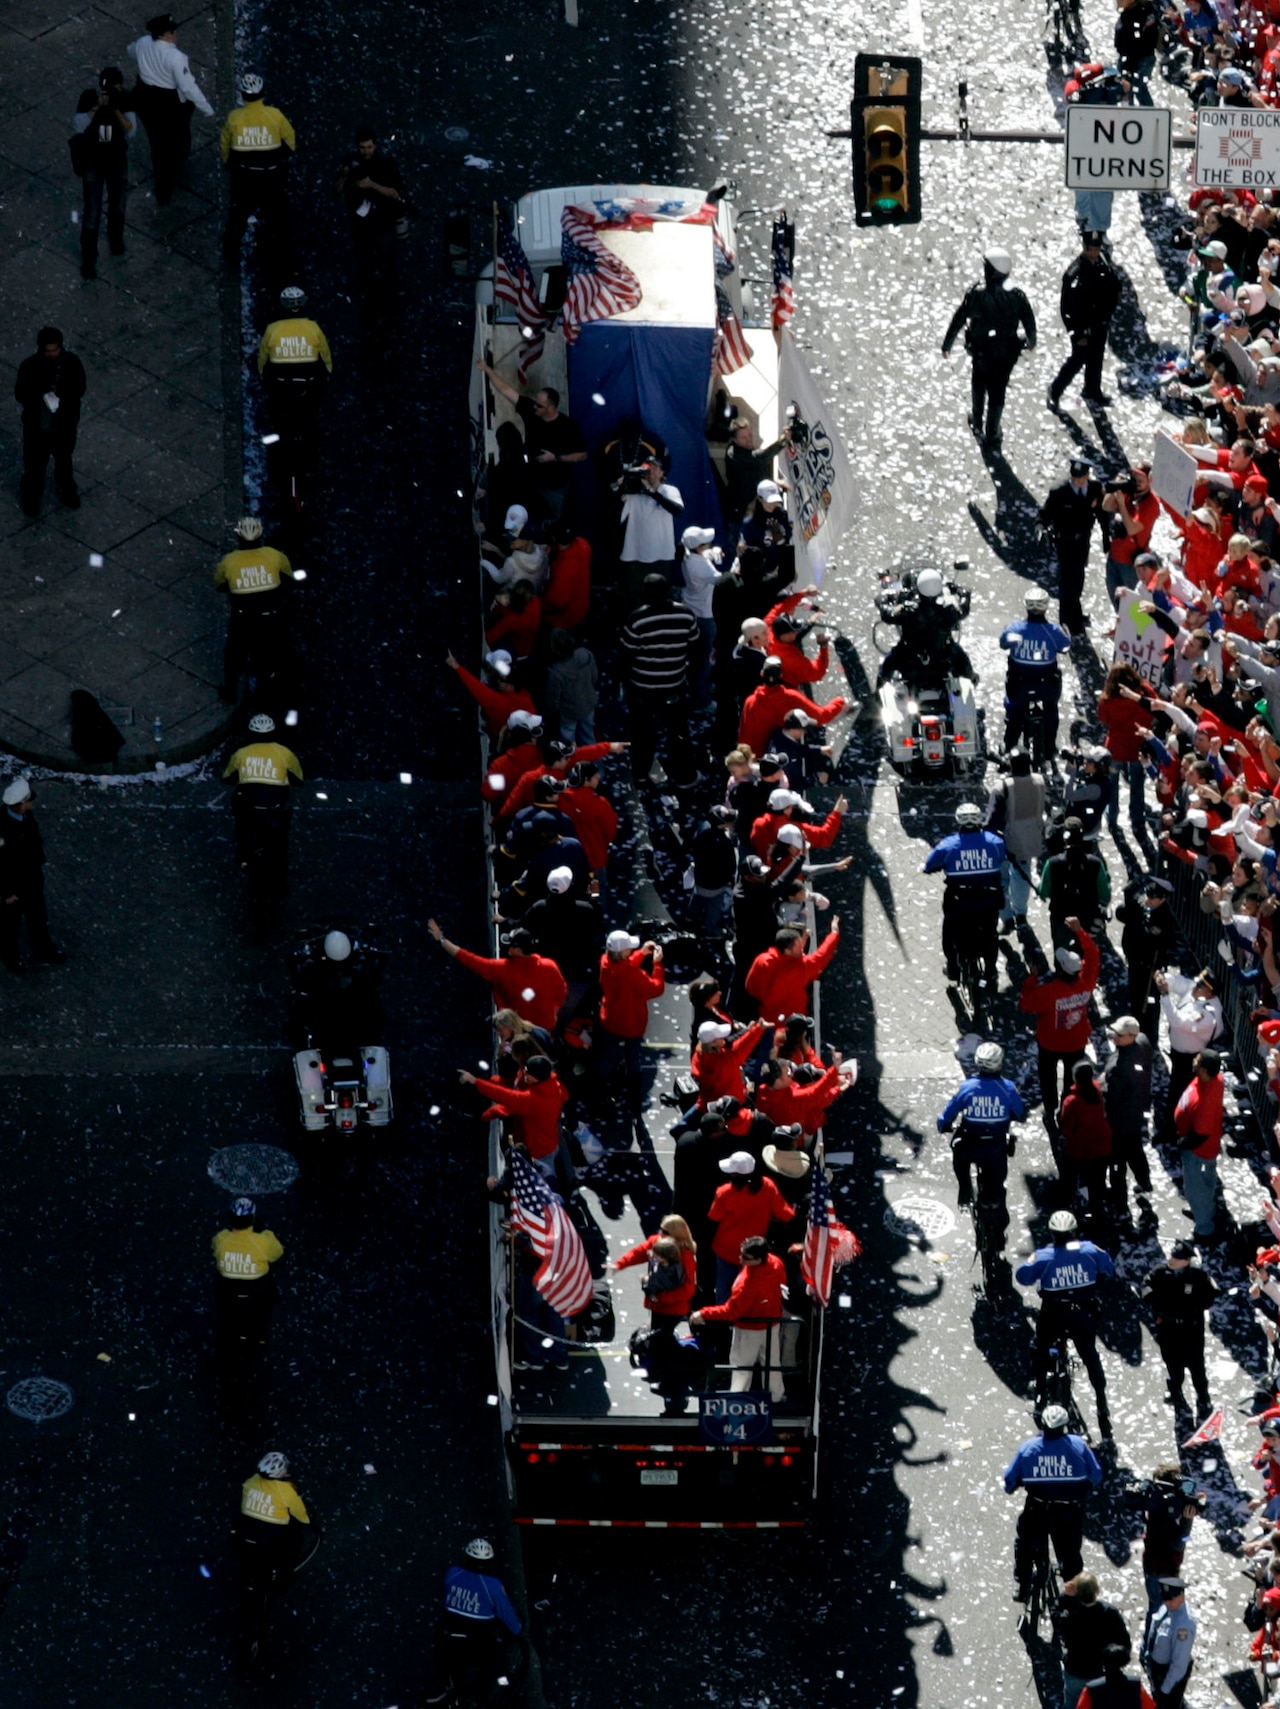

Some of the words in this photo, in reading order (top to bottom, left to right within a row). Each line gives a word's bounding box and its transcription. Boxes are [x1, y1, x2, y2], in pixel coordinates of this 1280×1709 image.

[1241, 112, 1280, 128] BLOCK
[243, 126, 268, 136] PHILA
[1093, 119, 1143, 145] NO
[238, 134, 273, 145] POLICE
[1071, 156, 1165, 178] TURNS
[1202, 168, 1233, 184] THE
[1243, 169, 1276, 185] BOX
[280, 336, 307, 347] PHILA
[275, 345, 312, 356] POLICE
[241, 565, 267, 577] PHILA
[236, 573, 274, 588] POLICE
[1015, 648, 1050, 660] POLE
[1118, 640, 1155, 661] out
[246, 757, 273, 768] PHILA
[960, 848, 987, 860] PHILA
[955, 857, 993, 871] POLICE
[972, 1096, 1000, 1107] PHILA
[968, 1105, 1005, 1117] POLICE
[224, 1251, 252, 1264] PHILA
[1055, 1263, 1084, 1277] PHILA
[1051, 1272, 1089, 1288] POLICE
[703, 1399, 769, 1416] Float
[723, 1424, 748, 1440] #4
[1038, 1455, 1067, 1466] PHILA
[1033, 1465, 1073, 1477] POLICE
[451, 1585, 479, 1603] PHILA
